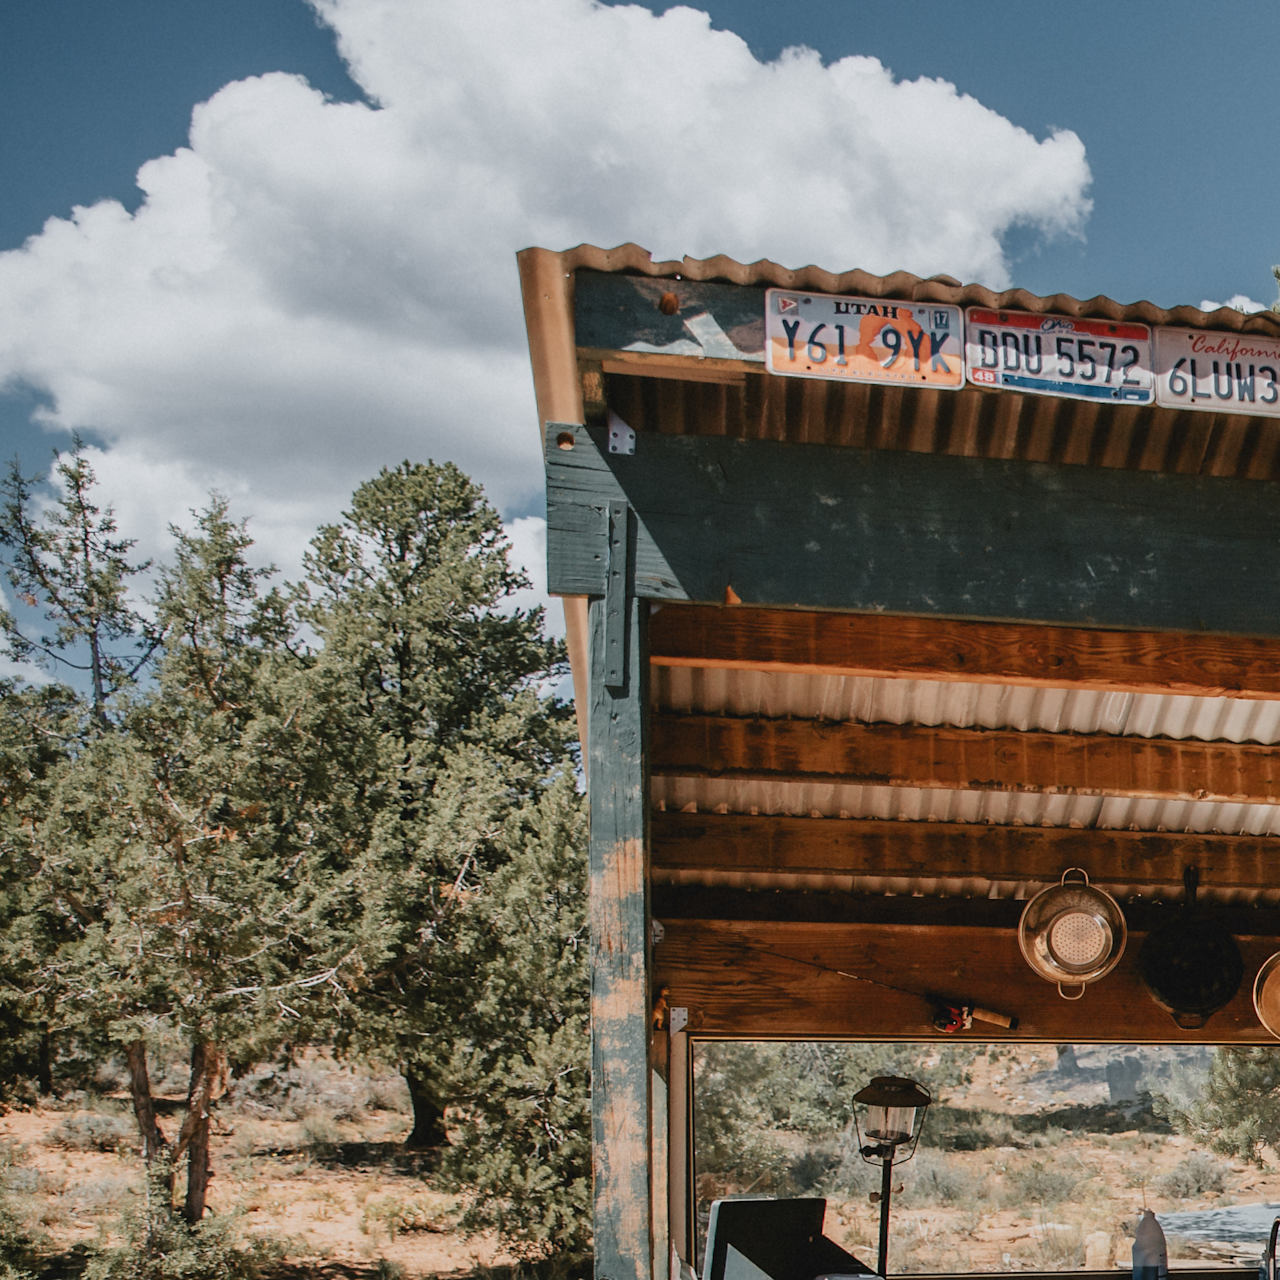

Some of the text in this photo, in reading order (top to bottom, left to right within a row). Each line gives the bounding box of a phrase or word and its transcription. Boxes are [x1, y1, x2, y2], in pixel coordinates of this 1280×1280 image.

[834, 302, 899, 319] UTAH
[1040, 319, 1075, 331] Ohio
[782, 319, 951, 373] Y61 9YK
[1056, 337, 1140, 385] 5572
[974, 371, 994, 382] 48
